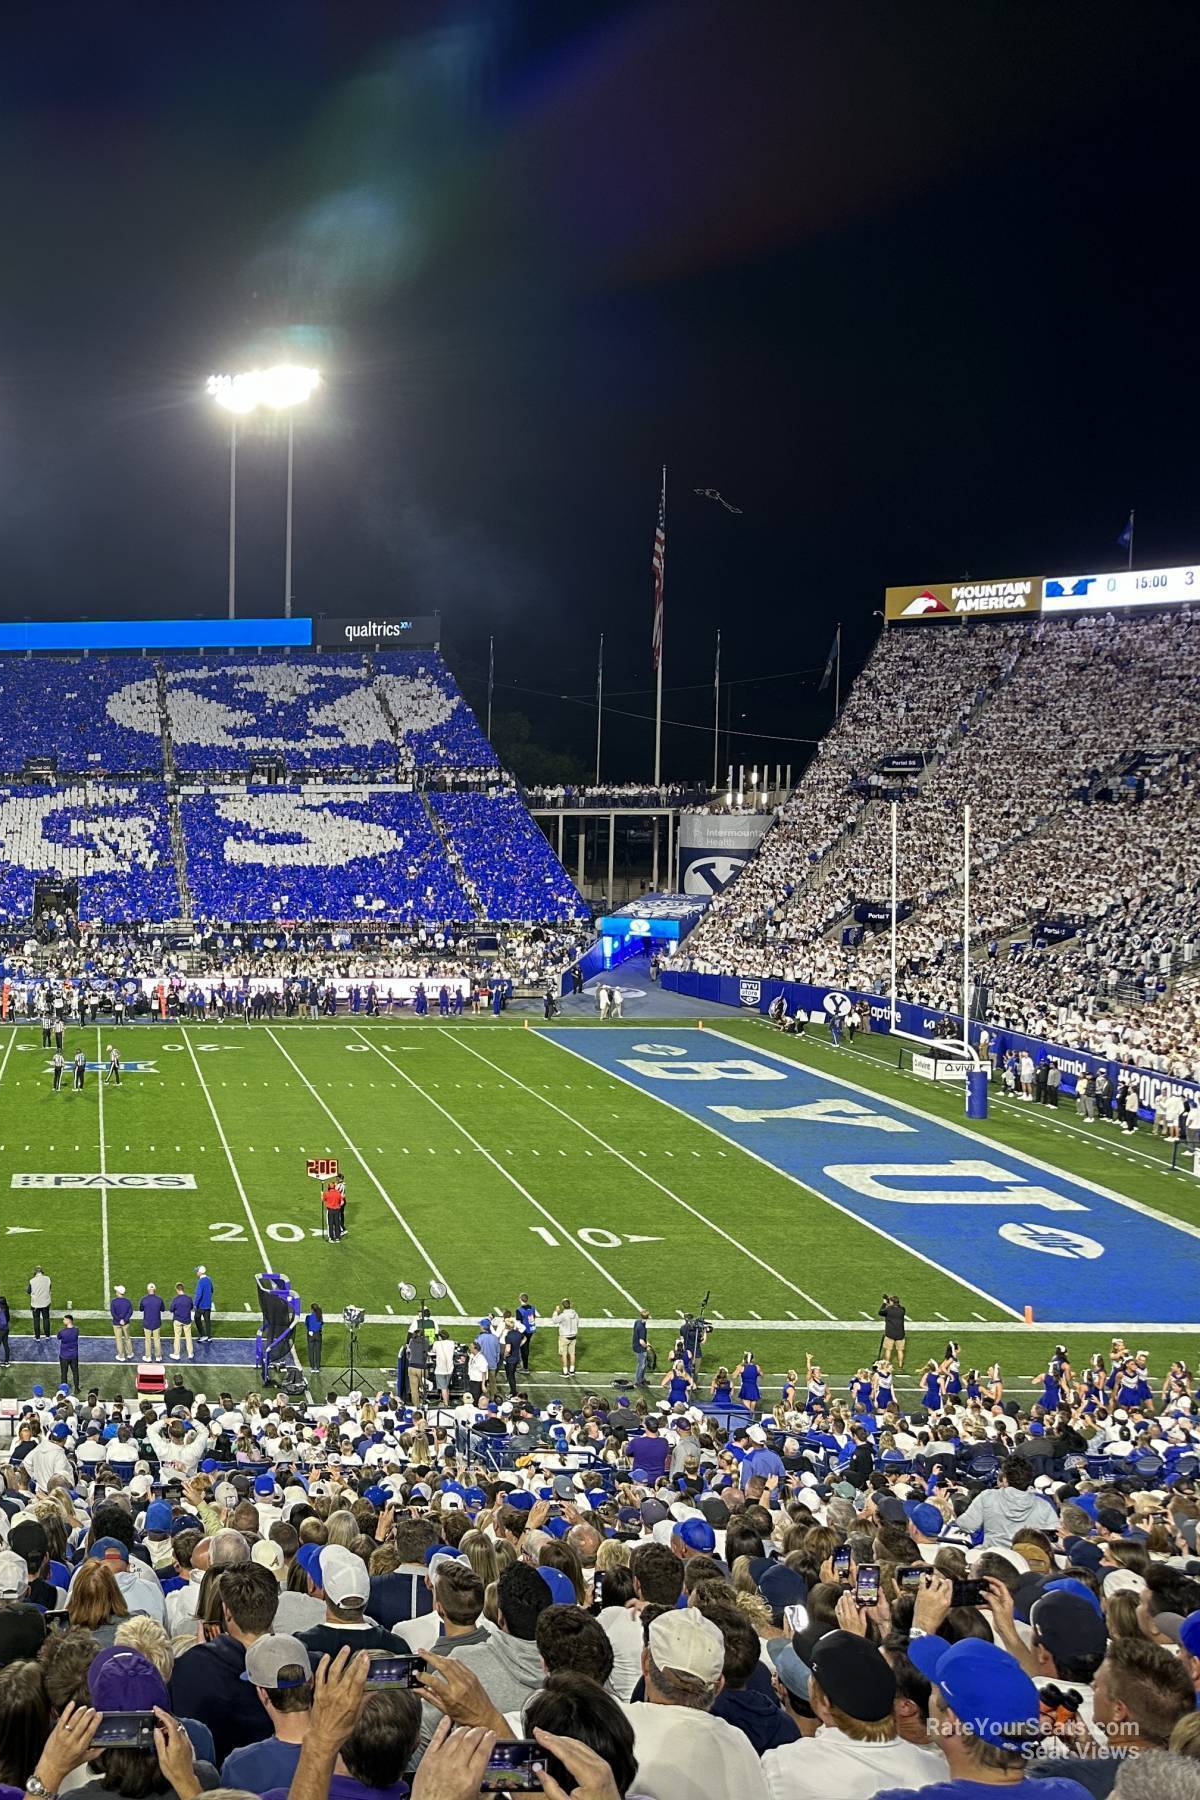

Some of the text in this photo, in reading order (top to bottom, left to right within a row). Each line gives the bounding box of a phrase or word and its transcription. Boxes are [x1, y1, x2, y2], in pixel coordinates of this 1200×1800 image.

[1106, 577, 1116, 591] 0
[1135, 575, 1168, 590] 15:00
[1185, 571, 1194, 585] 3
[951, 581, 1031, 600] MOUNTAIN
[955, 595, 1026, 612] AMERICA
[345, 621, 400, 641] qualtrics
[706, 838, 735, 846] Health
[742, 982, 758, 991] BYU
[616, 1059, 1092, 1211] BYU
[54, 1176, 186, 1186] PACS
[208, 1222, 306, 1242] 20
[529, 1226, 623, 1248] 10
